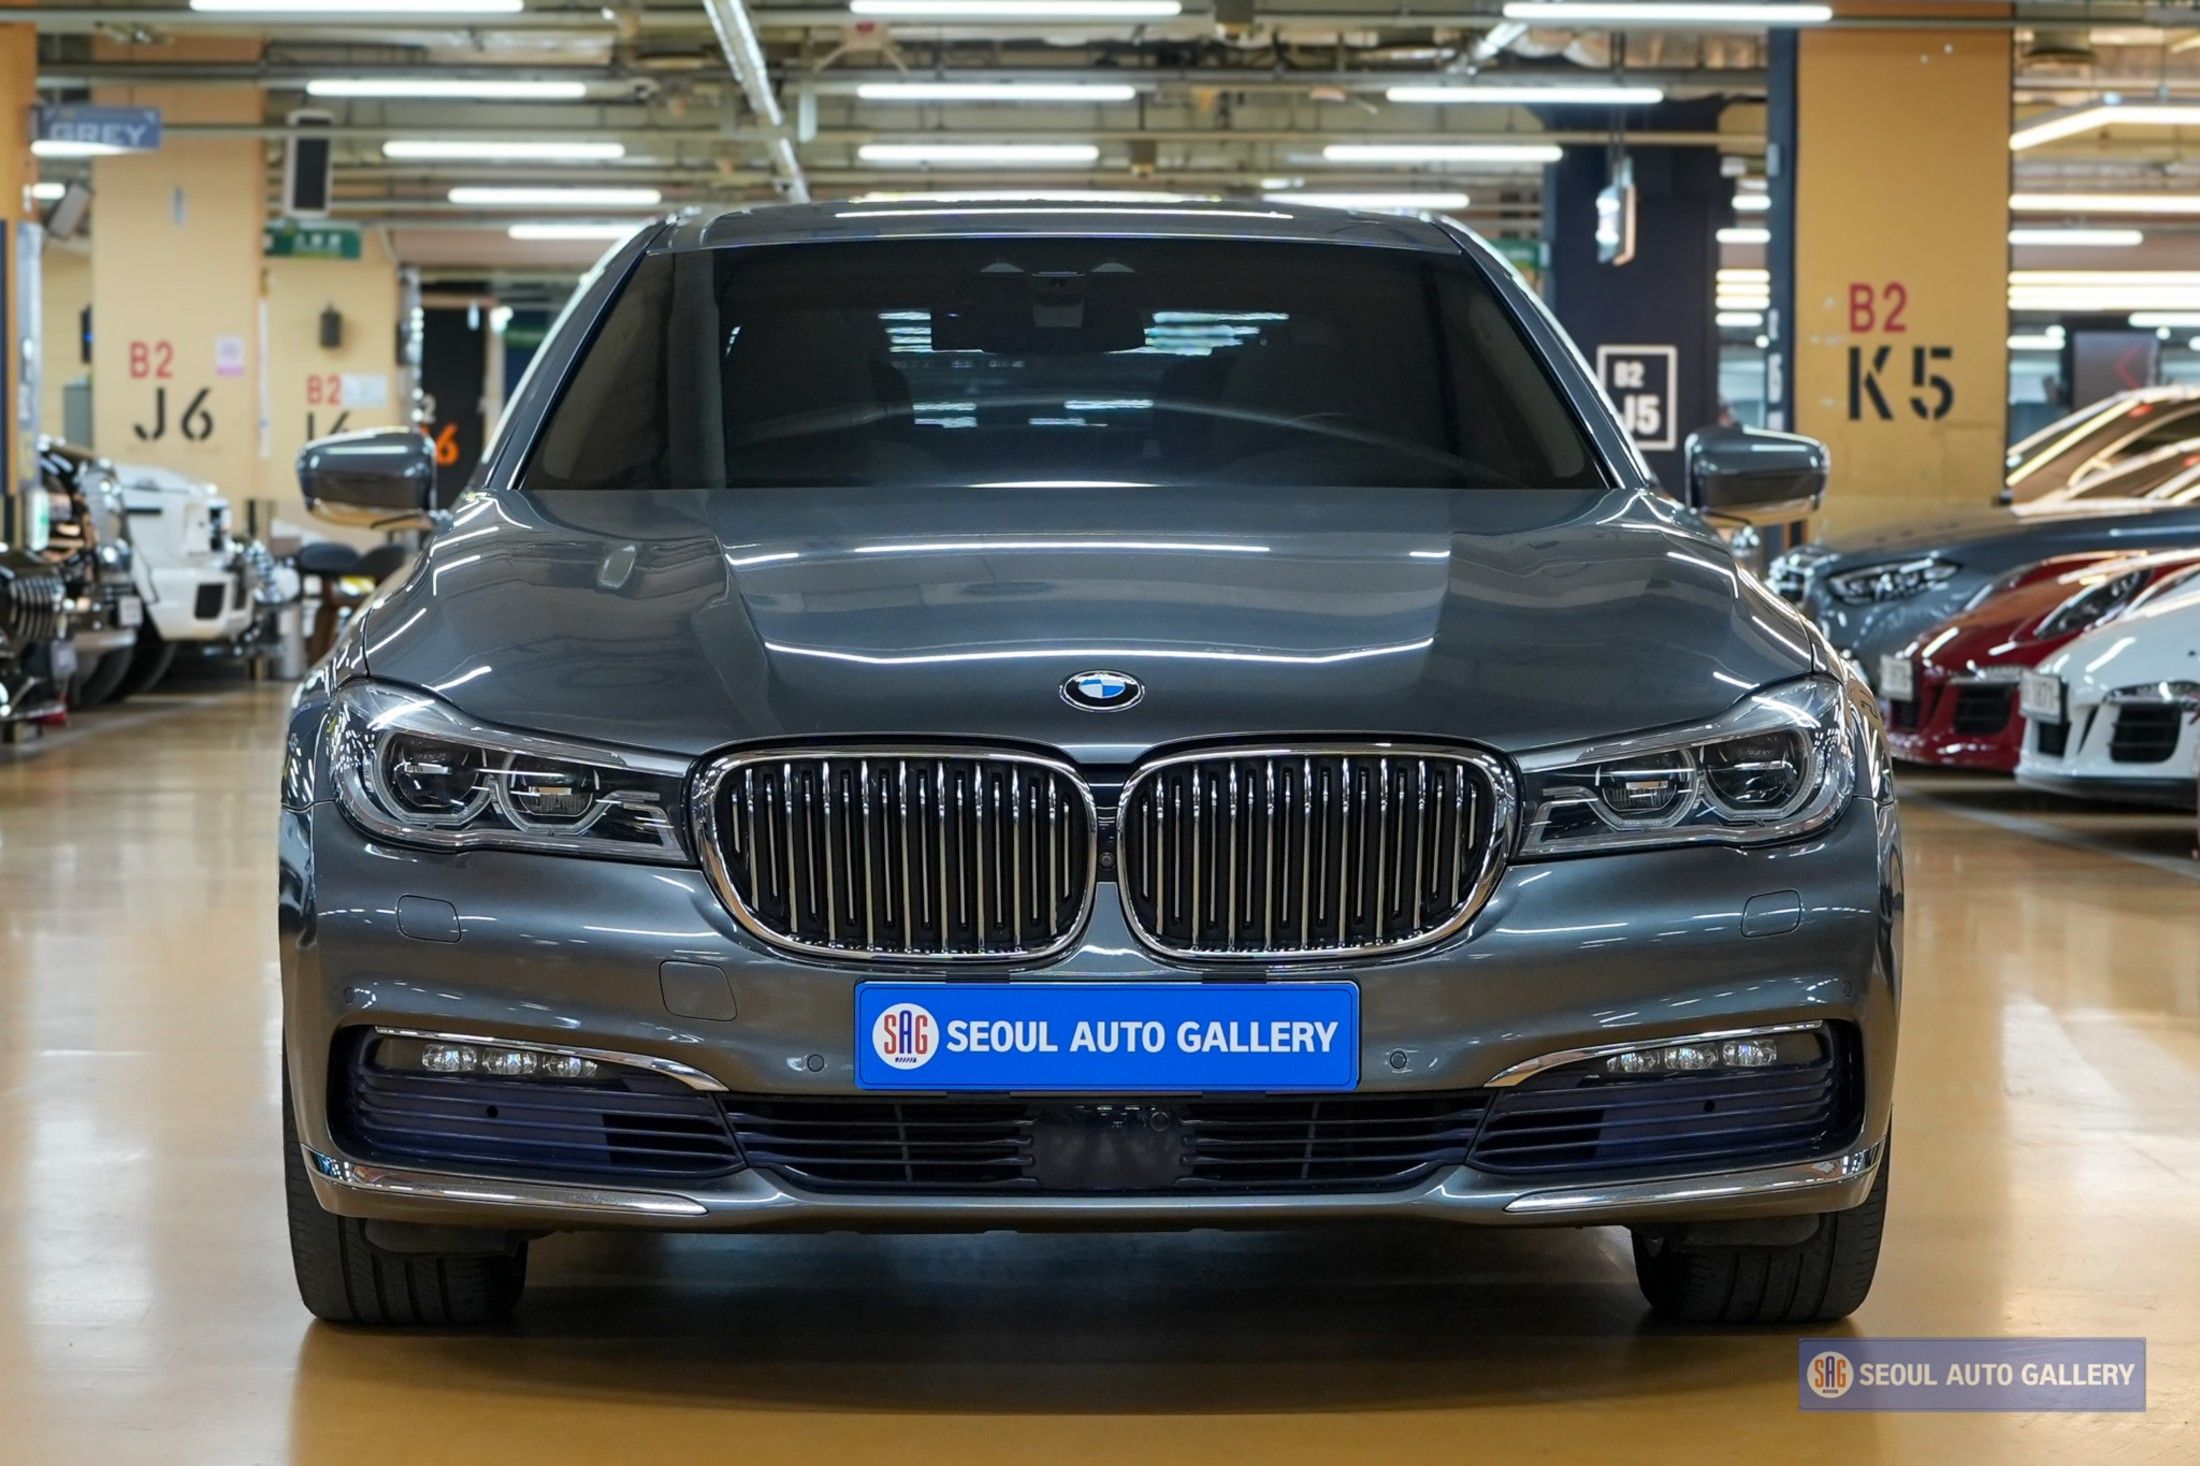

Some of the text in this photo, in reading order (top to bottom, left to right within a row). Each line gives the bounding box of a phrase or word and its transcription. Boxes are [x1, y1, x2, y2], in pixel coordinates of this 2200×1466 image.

[1850, 281, 1907, 333] B2
[129, 339, 175, 379] B2
[1614, 361, 1645, 388] B2
[307, 373, 342, 406] B2
[1848, 344, 1954, 421] K5
[133, 386, 214, 441] J6
[883, 1009, 929, 1055] SAG
[946, 1020, 1339, 1053] SEOUL AUTO GALLERY
